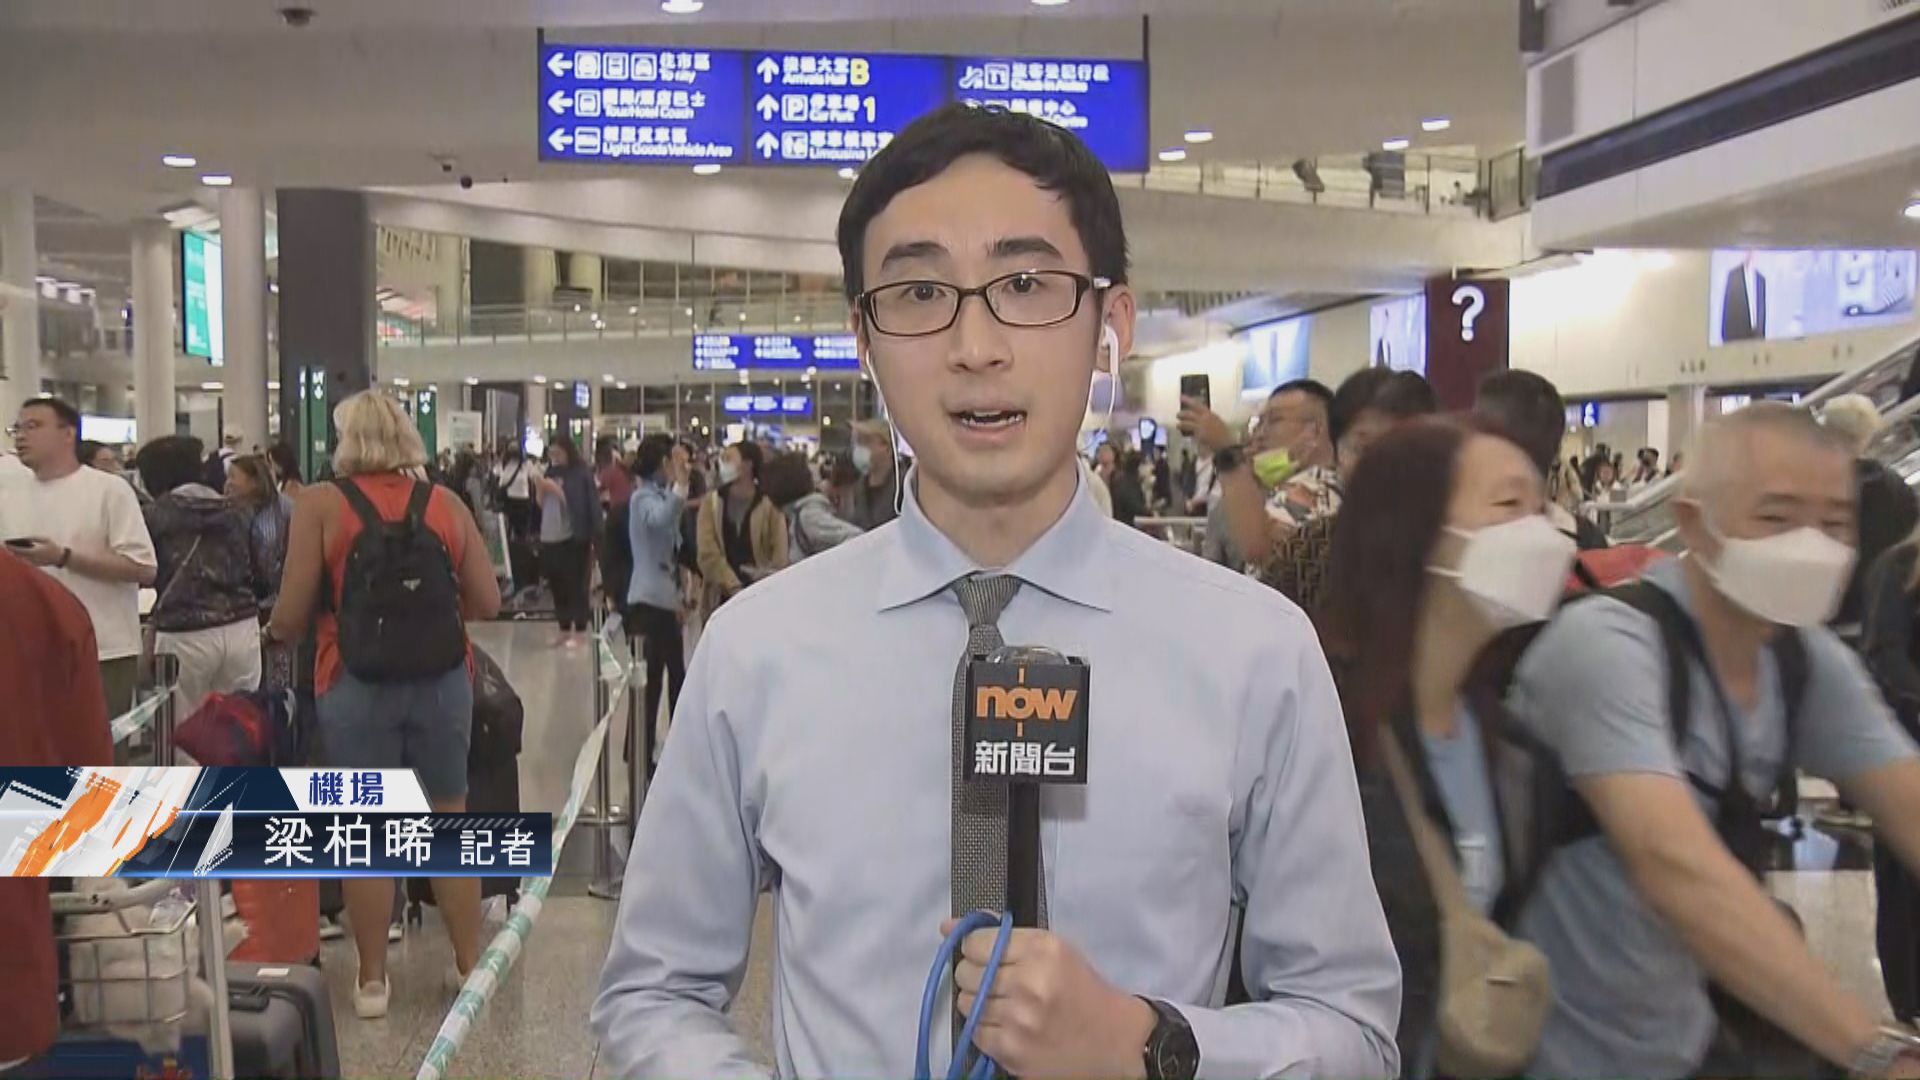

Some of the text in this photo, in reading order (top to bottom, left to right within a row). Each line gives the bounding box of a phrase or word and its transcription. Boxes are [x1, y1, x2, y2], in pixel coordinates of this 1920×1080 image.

[659, 68, 696, 84] To city
[850, 58, 870, 85] B
[810, 109, 854, 122] Car Park
[863, 96, 875, 122] 1
[603, 142, 630, 157] Light
[632, 143, 668, 156] Goods
[706, 143, 732, 157] Area
[975, 685, 1078, 720] now
[974, 740, 1076, 776] 新聞台
